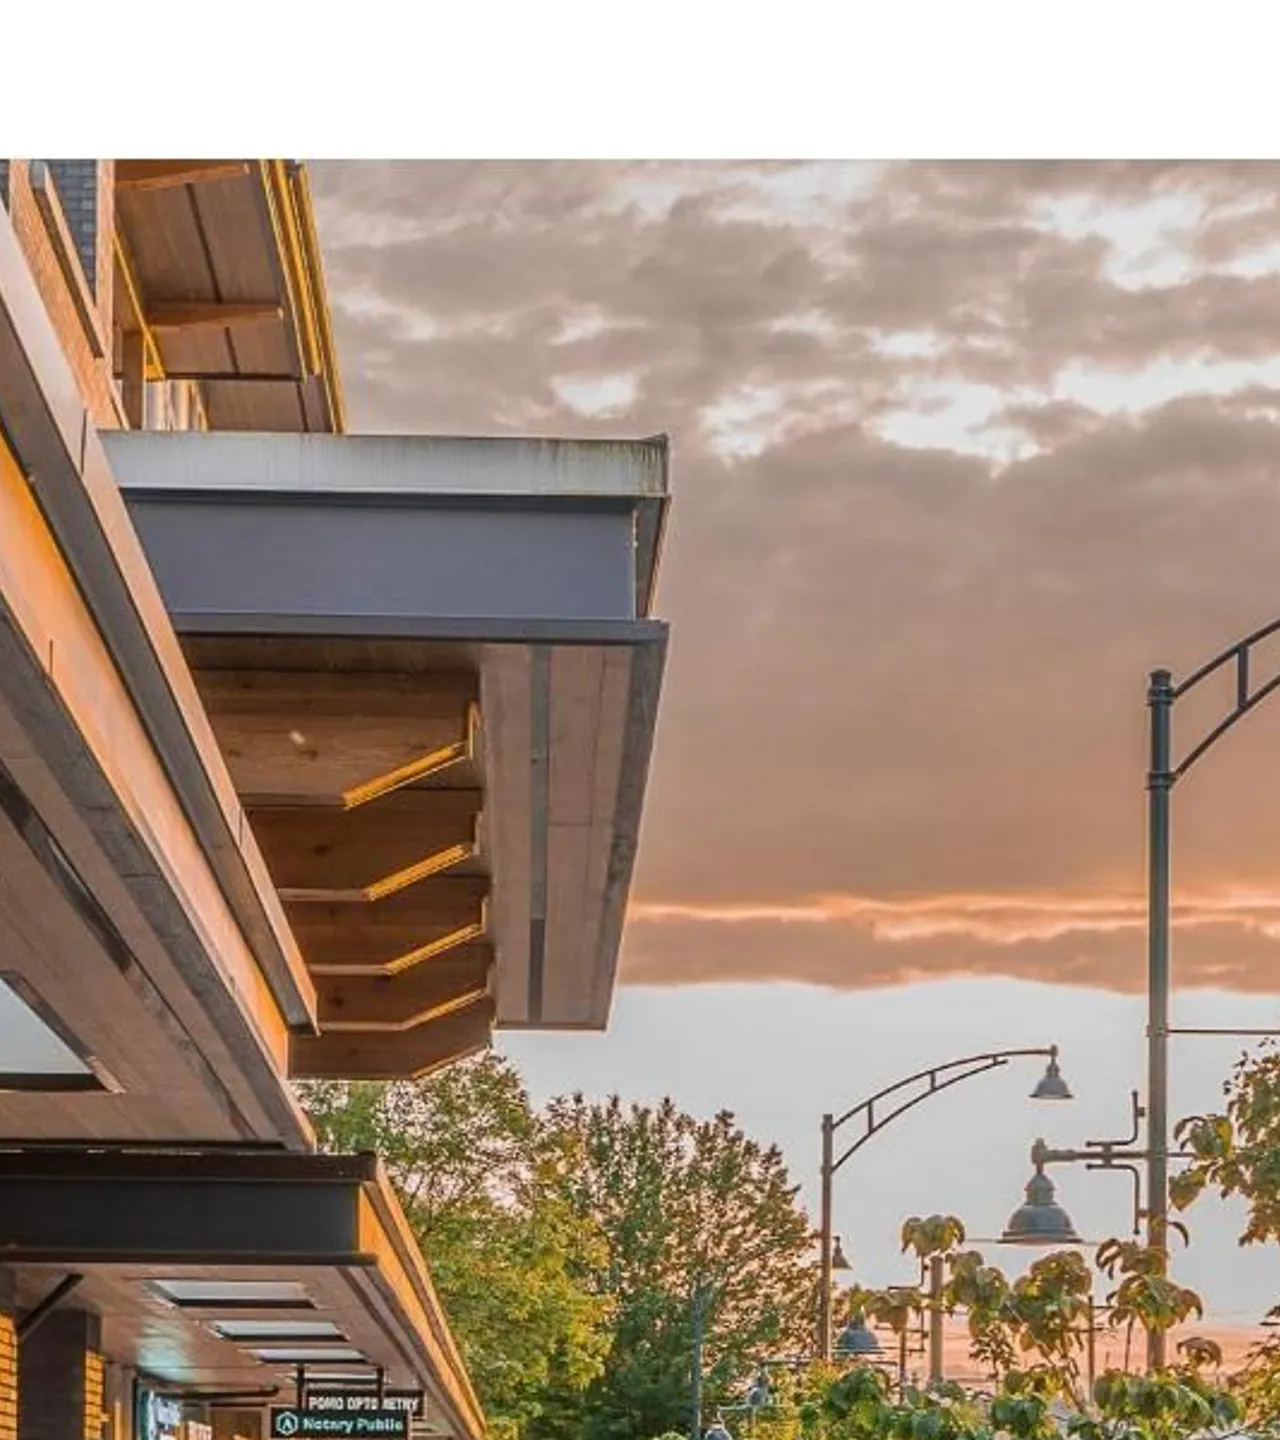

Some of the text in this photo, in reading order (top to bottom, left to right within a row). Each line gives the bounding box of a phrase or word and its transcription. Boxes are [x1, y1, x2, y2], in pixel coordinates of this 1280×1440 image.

[308, 1396, 344, 1411] POMO
[303, 1417, 404, 1435] Notary Public
